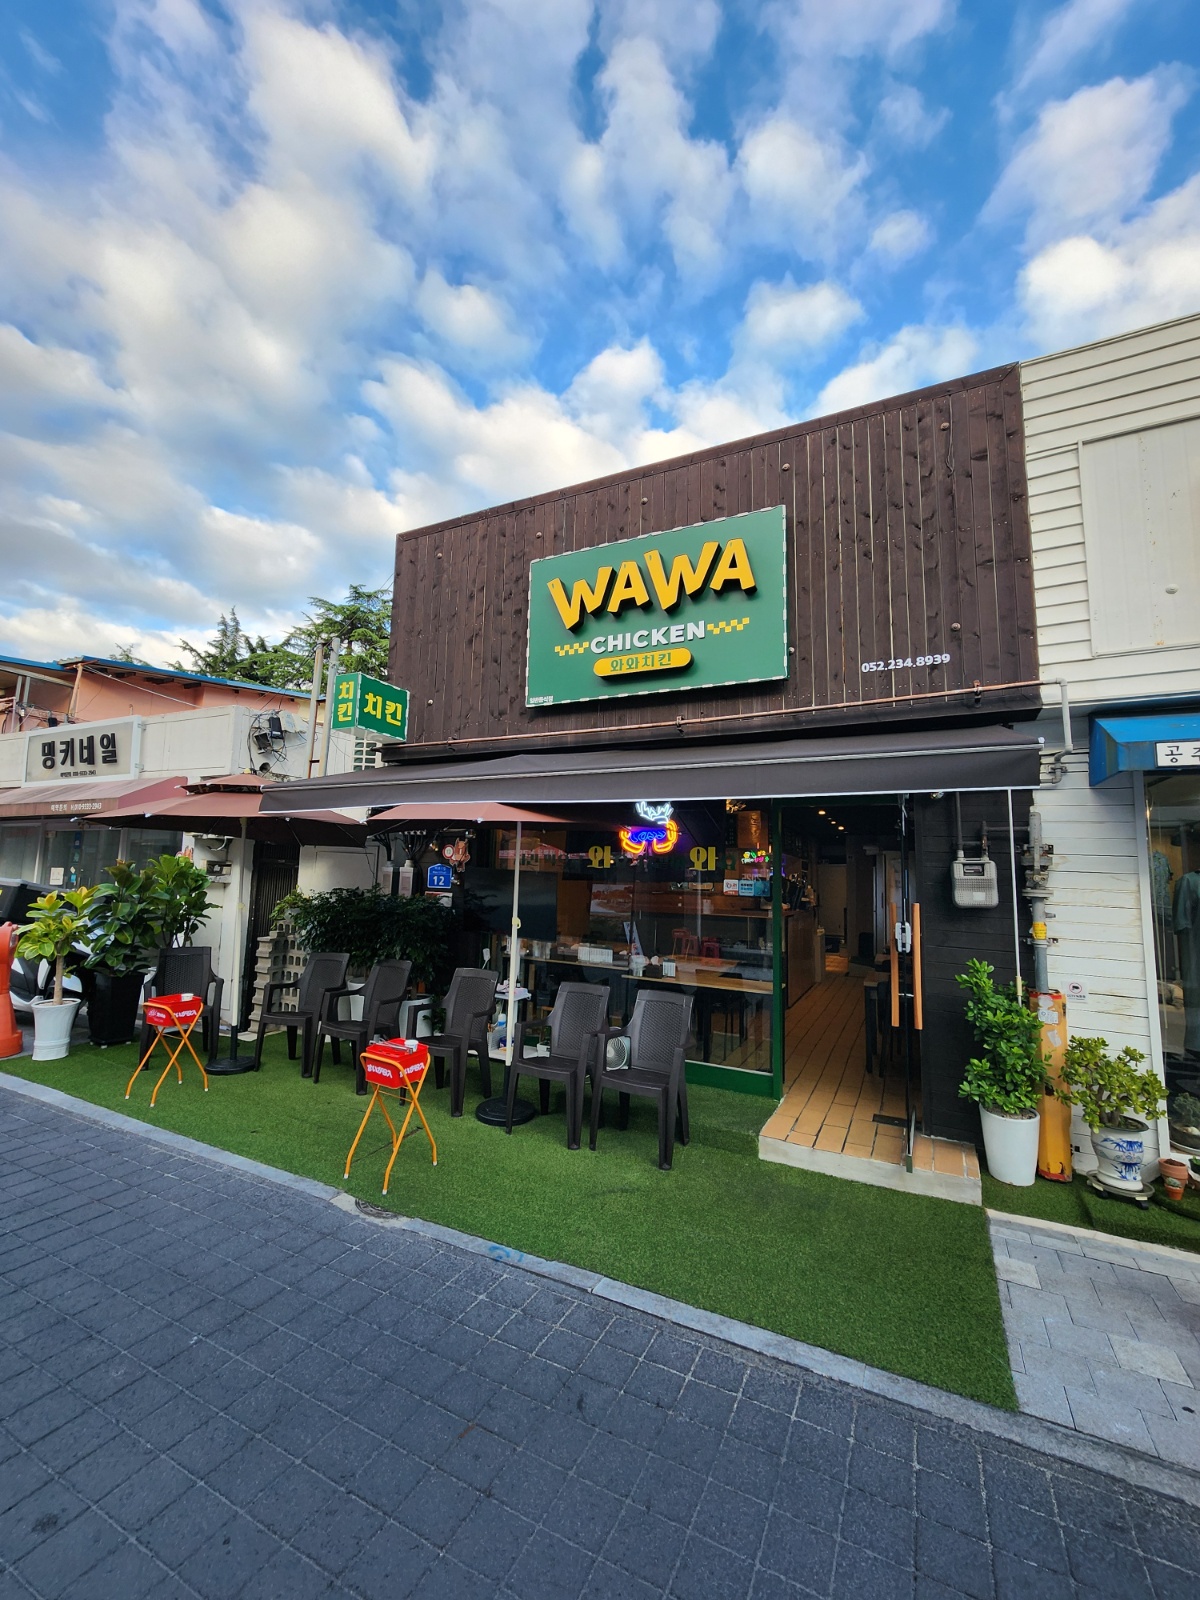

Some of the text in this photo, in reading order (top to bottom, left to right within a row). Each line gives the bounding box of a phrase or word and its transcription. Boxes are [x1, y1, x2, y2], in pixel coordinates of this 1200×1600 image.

[547, 538, 757, 630] WAWA
[590, 620, 705, 654] CHICKEN
[610, 652, 672, 672] 와와치킨
[861, 653, 951, 673] 052.234.8939
[337, 681, 355, 722] 치킨
[363, 692, 403, 727] 치킨
[41, 733, 118, 770] 밍키네일
[586, 845, 613, 869] 와
[688, 846, 719, 871] 와
[433, 876, 445, 886] 12
